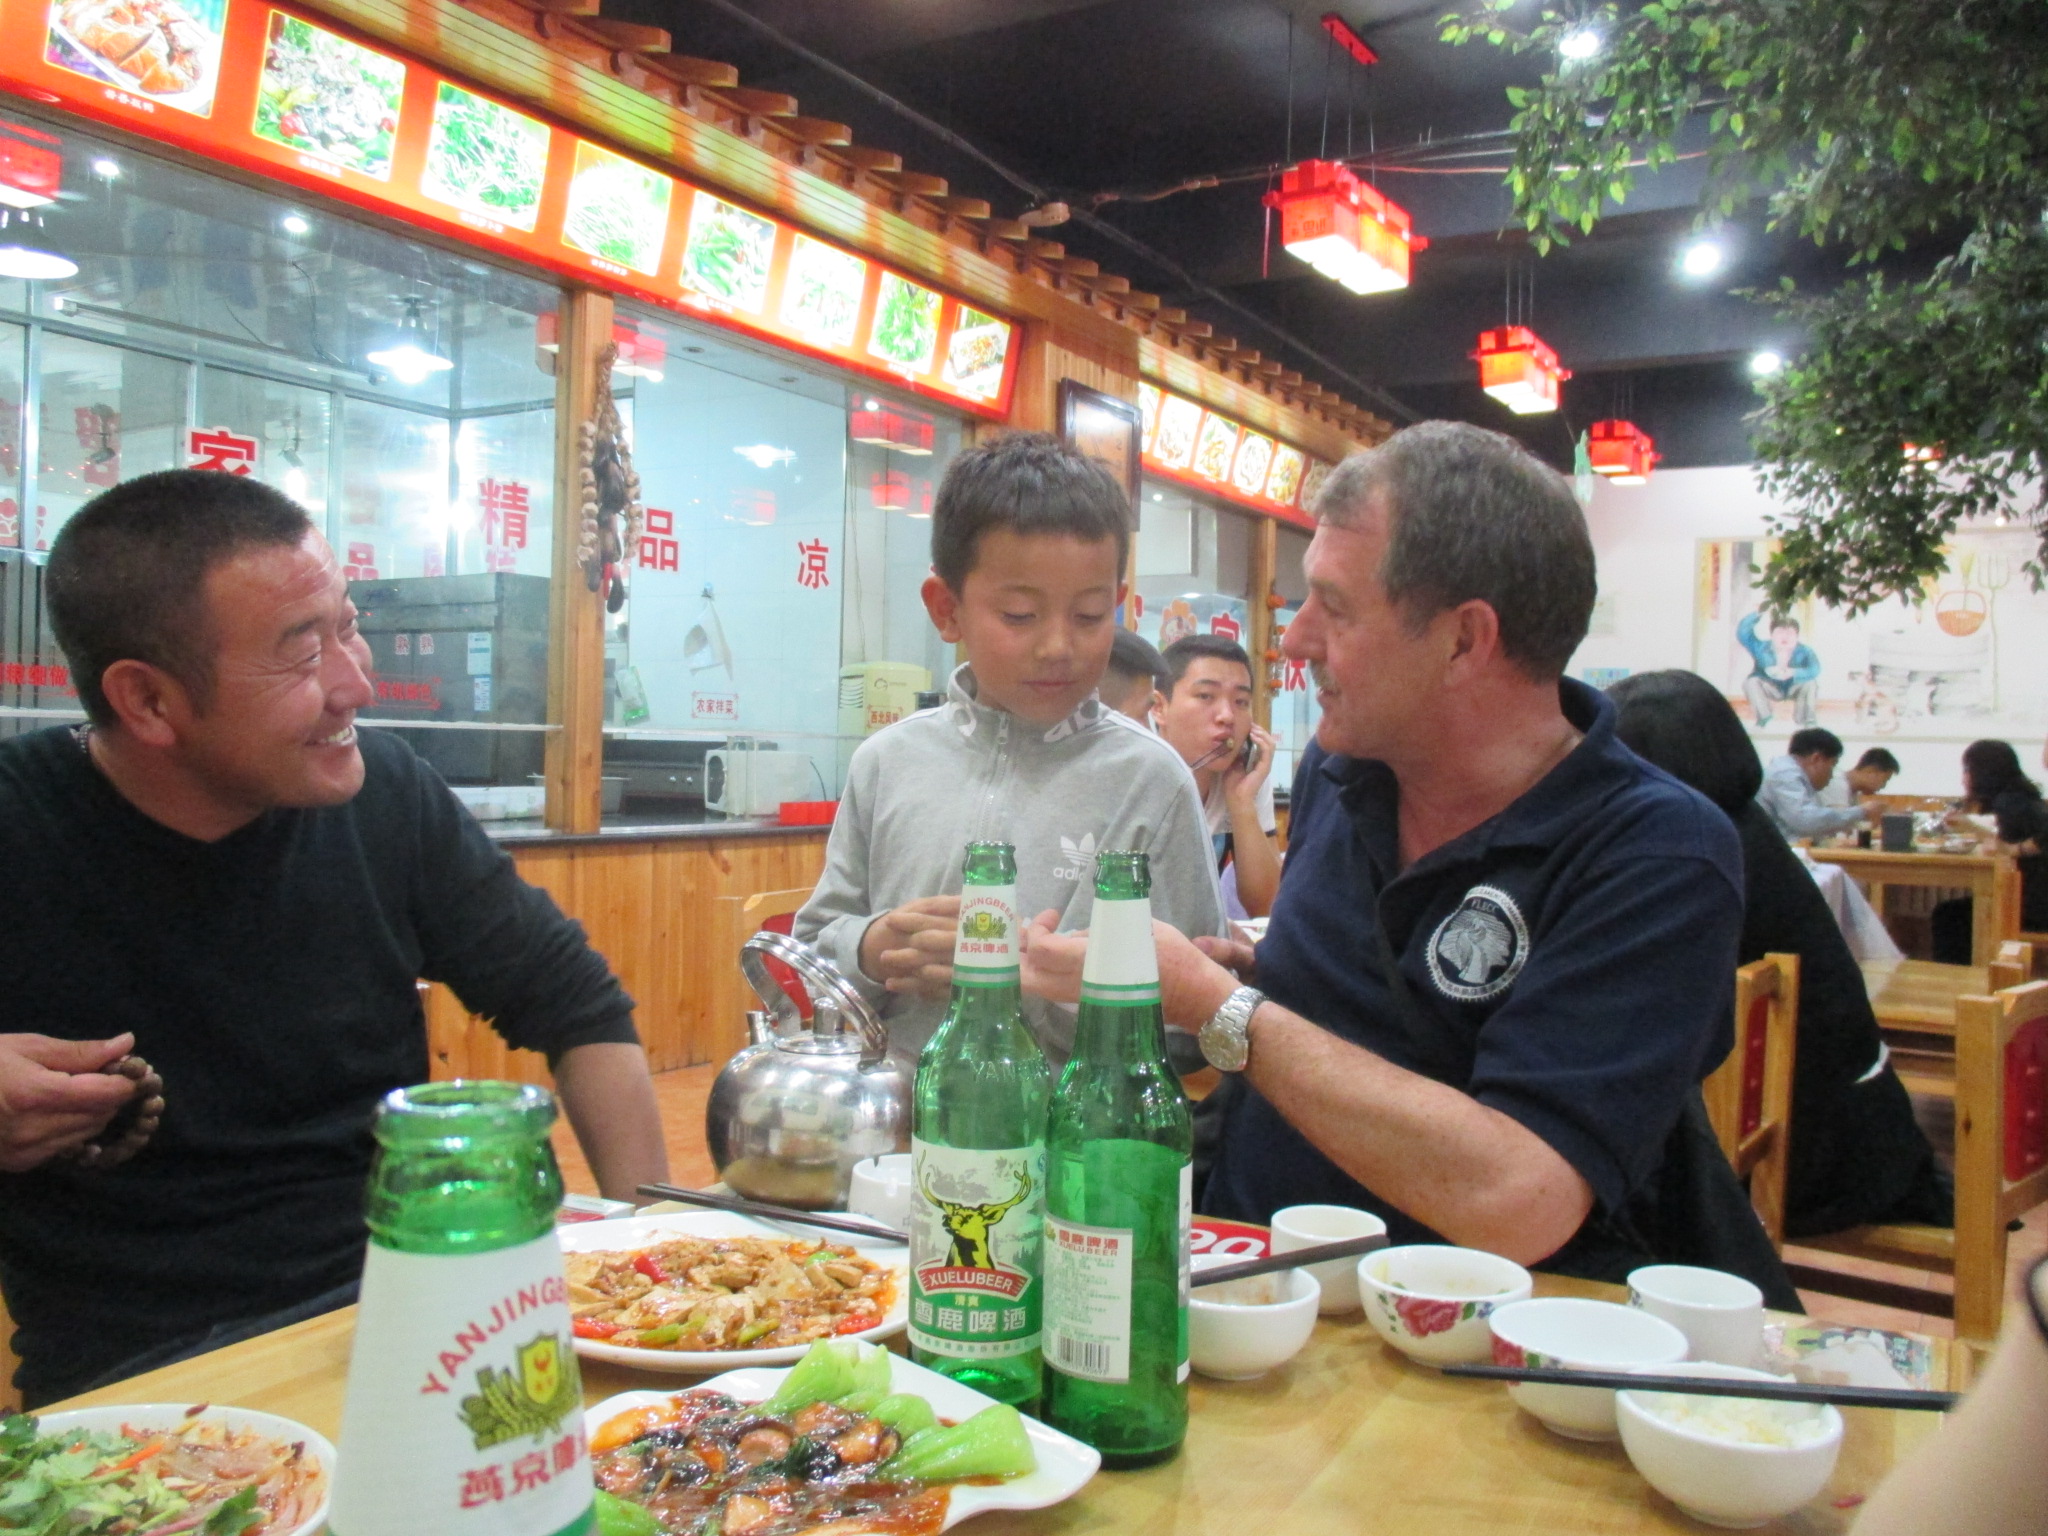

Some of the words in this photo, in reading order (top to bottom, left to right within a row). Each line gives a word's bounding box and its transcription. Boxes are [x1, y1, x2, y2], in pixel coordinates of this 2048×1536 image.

[478, 478, 531, 549] 精
[639, 507, 679, 572] 品
[797, 537, 830, 590] 凉
[0, 661, 70, 687] 粮细做
[696, 698, 735, 716] 农家拌菜
[928, 1270, 1014, 1292] XUELUBEER
[914, 1298, 1027, 1334] 雪鹿啤酒
[458, 1424, 588, 1509] 燕京啤
